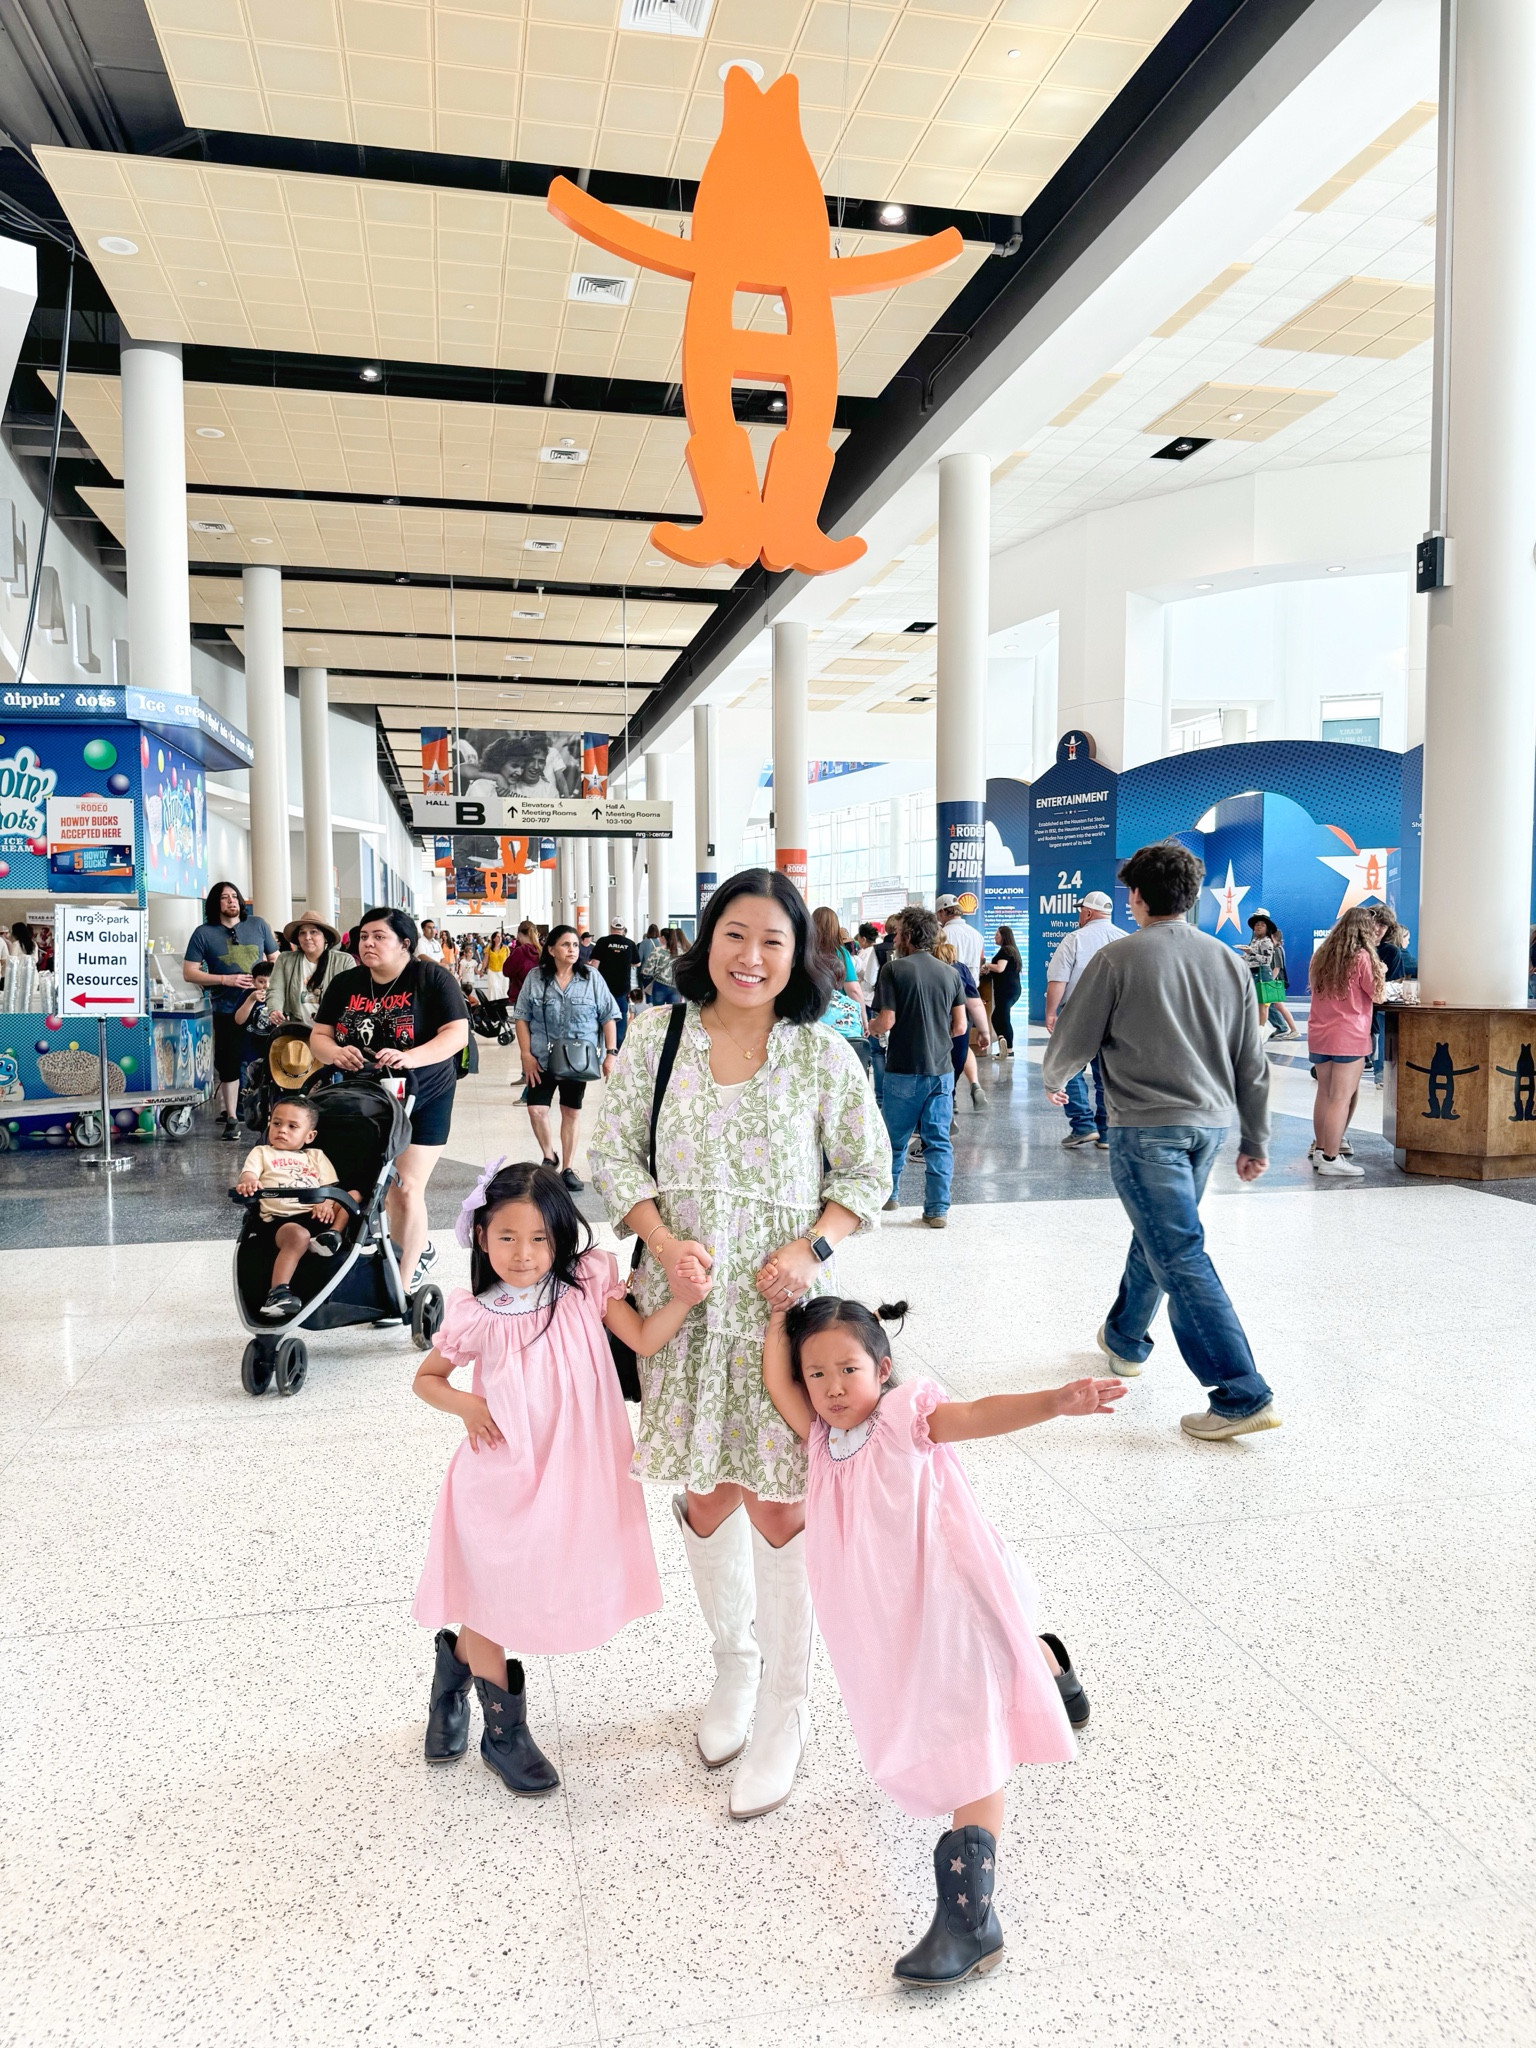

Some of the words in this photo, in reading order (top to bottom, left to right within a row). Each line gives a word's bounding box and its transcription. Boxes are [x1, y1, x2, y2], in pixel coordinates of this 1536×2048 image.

[75, 693, 117, 707] dots
[139, 695, 166, 713] Ice
[1036, 791, 1109, 808] ENTERTAINMENT
[80, 803, 108, 813] RODEO
[455, 802, 486, 826] B
[0, 809, 38, 831] ots
[60, 816, 90, 827] HOWDY
[91, 815, 119, 826] BUCKS
[60, 828, 101, 839] ACCEPTED
[102, 828, 122, 838] HERE
[635, 831, 646, 839] nrg
[3, 837, 24, 845] ICE
[73, 852, 83, 869] 5
[83, 850, 109, 860] HOWDY
[83, 859, 107, 868] BUCKS
[947, 860, 983, 878] PRIDE
[1057, 870, 1083, 890] 2.4
[75, 914, 94, 925] nrg
[106, 915, 130, 925] park
[66, 931, 94, 942] ASM
[98, 931, 138, 943] Global
[78, 952, 127, 965] Human
[66, 973, 139, 986] Resources
[347, 993, 377, 1013] NEW
